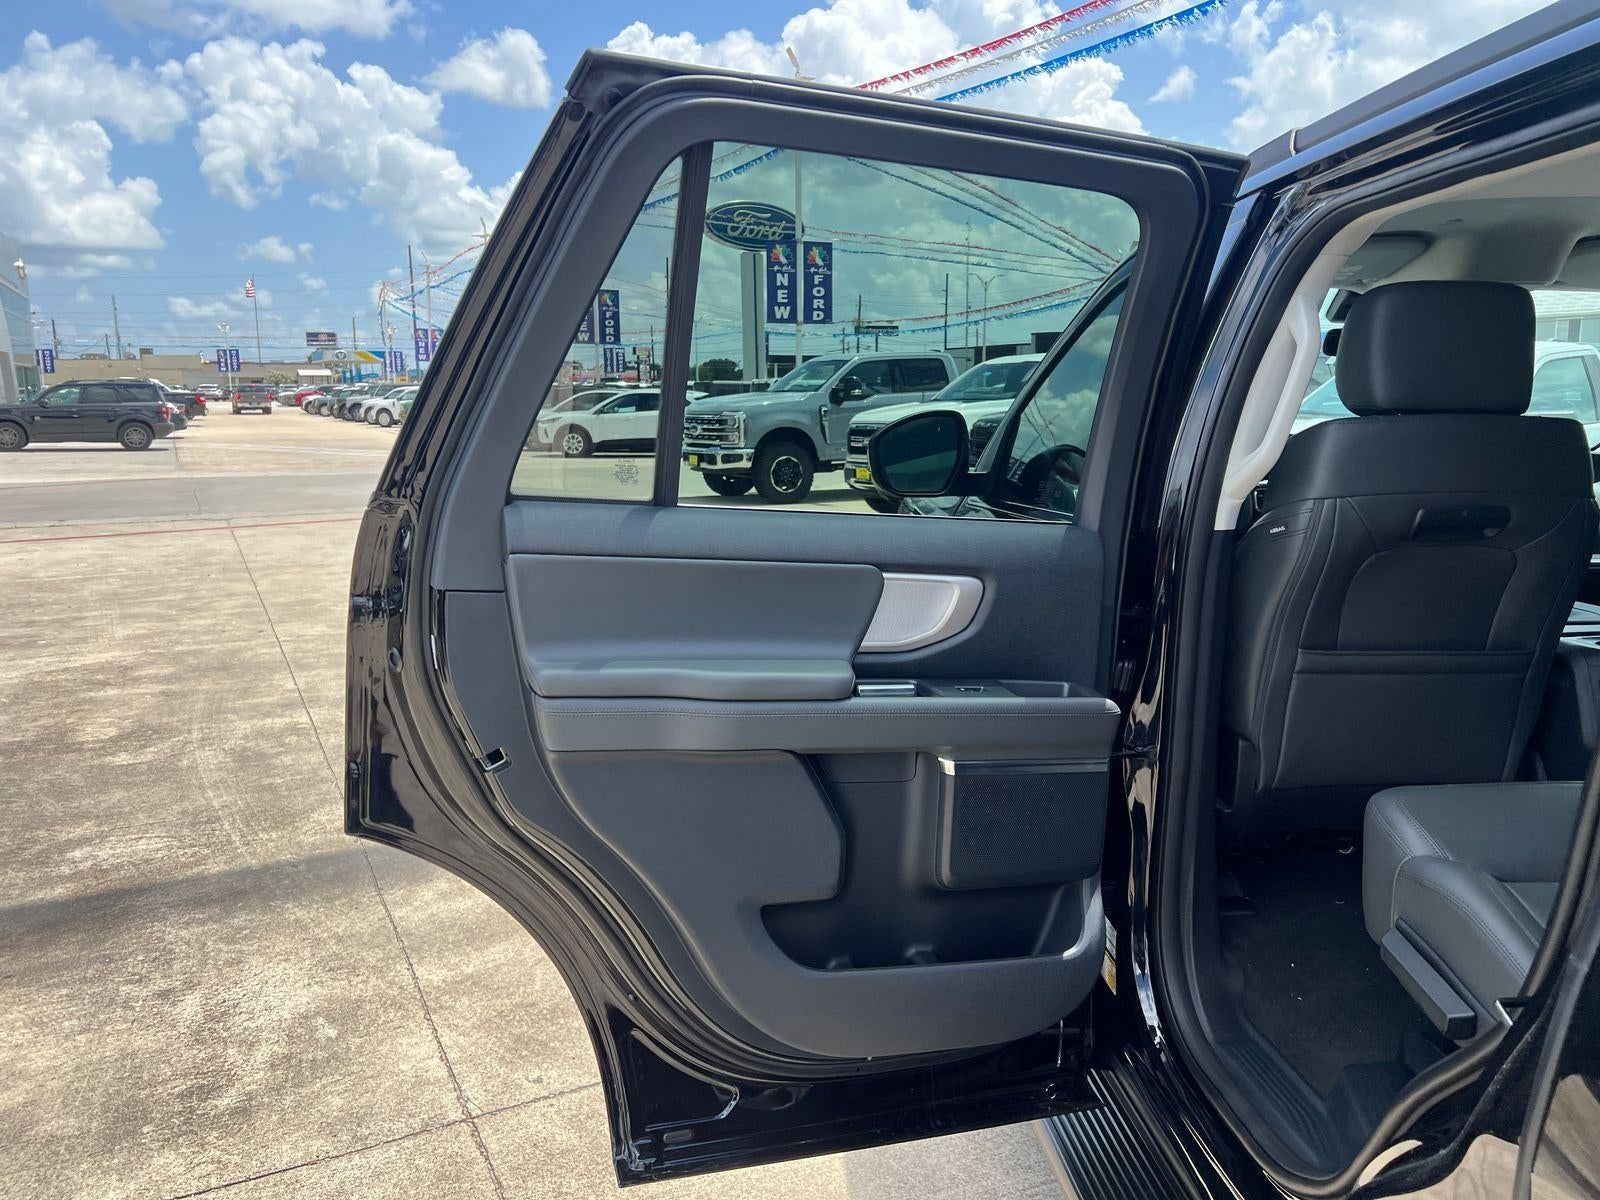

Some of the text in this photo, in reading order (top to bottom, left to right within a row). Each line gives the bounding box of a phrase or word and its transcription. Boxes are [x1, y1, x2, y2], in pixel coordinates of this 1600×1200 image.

[727, 209, 785, 241] Ford
[774, 273, 790, 319] NEW
[812, 275, 825, 320] FORD
[605, 311, 615, 343] FORD
[418, 341, 426, 360] NEW
